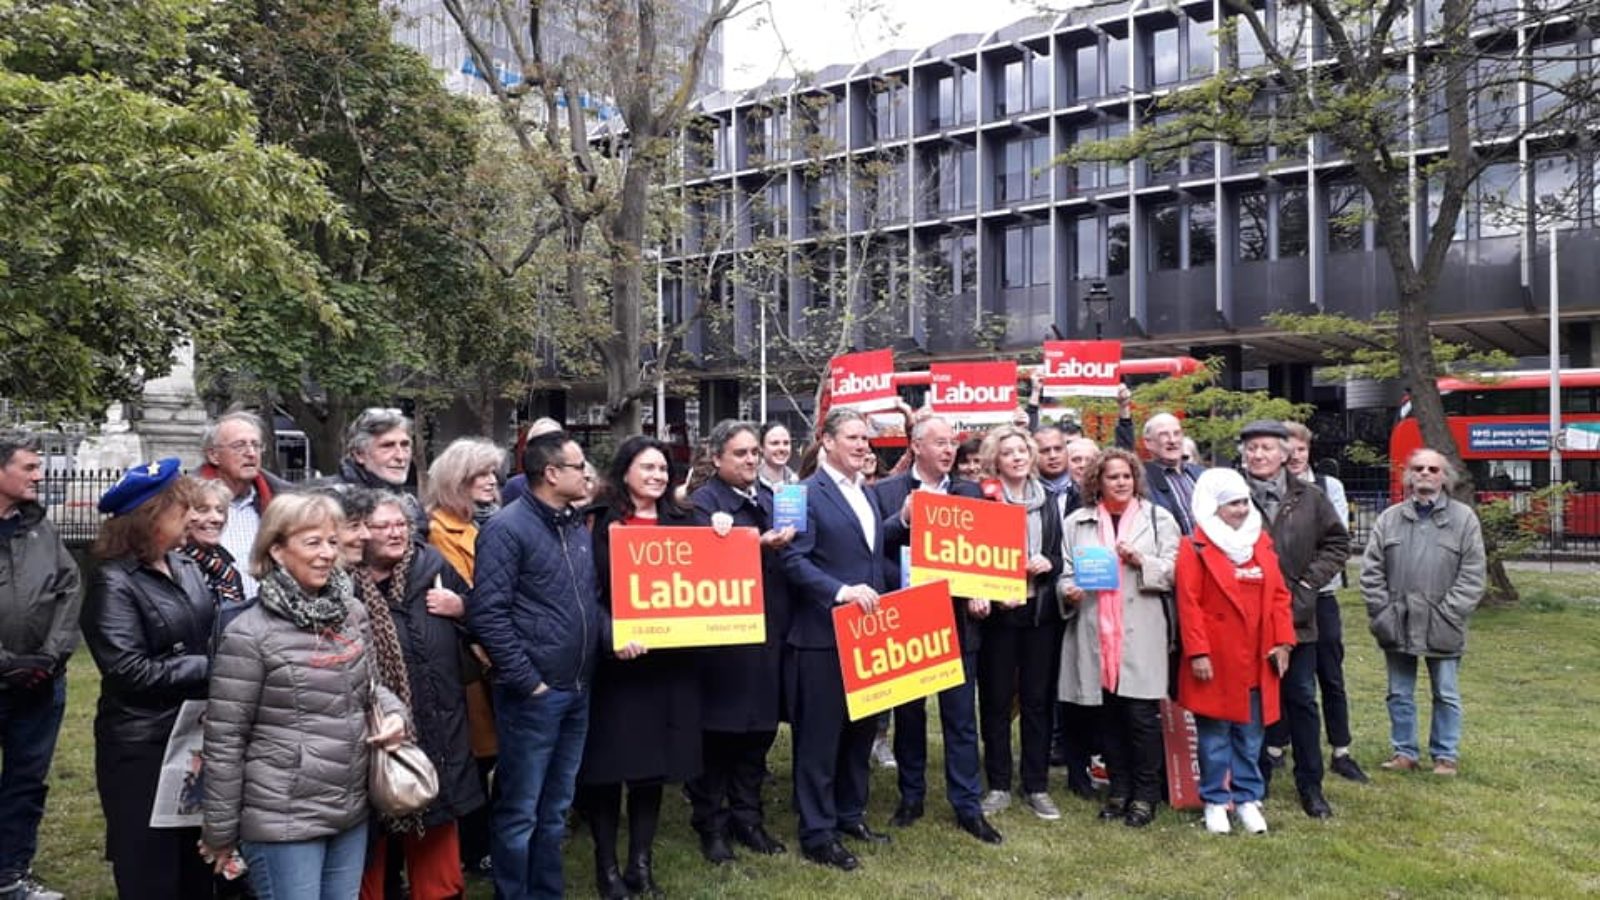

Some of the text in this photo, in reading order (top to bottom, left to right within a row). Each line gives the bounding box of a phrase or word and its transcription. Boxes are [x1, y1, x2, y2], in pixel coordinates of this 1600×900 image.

[1045, 357, 1118, 379] Labour
[832, 372, 893, 397] Labour
[931, 381, 1014, 405] Labour
[925, 504, 974, 531] vote
[628, 536, 693, 566] vote
[924, 530, 1022, 572] Labour
[628, 571, 757, 611] Labour
[848, 606, 900, 640] vote
[852, 626, 952, 680] Labour
